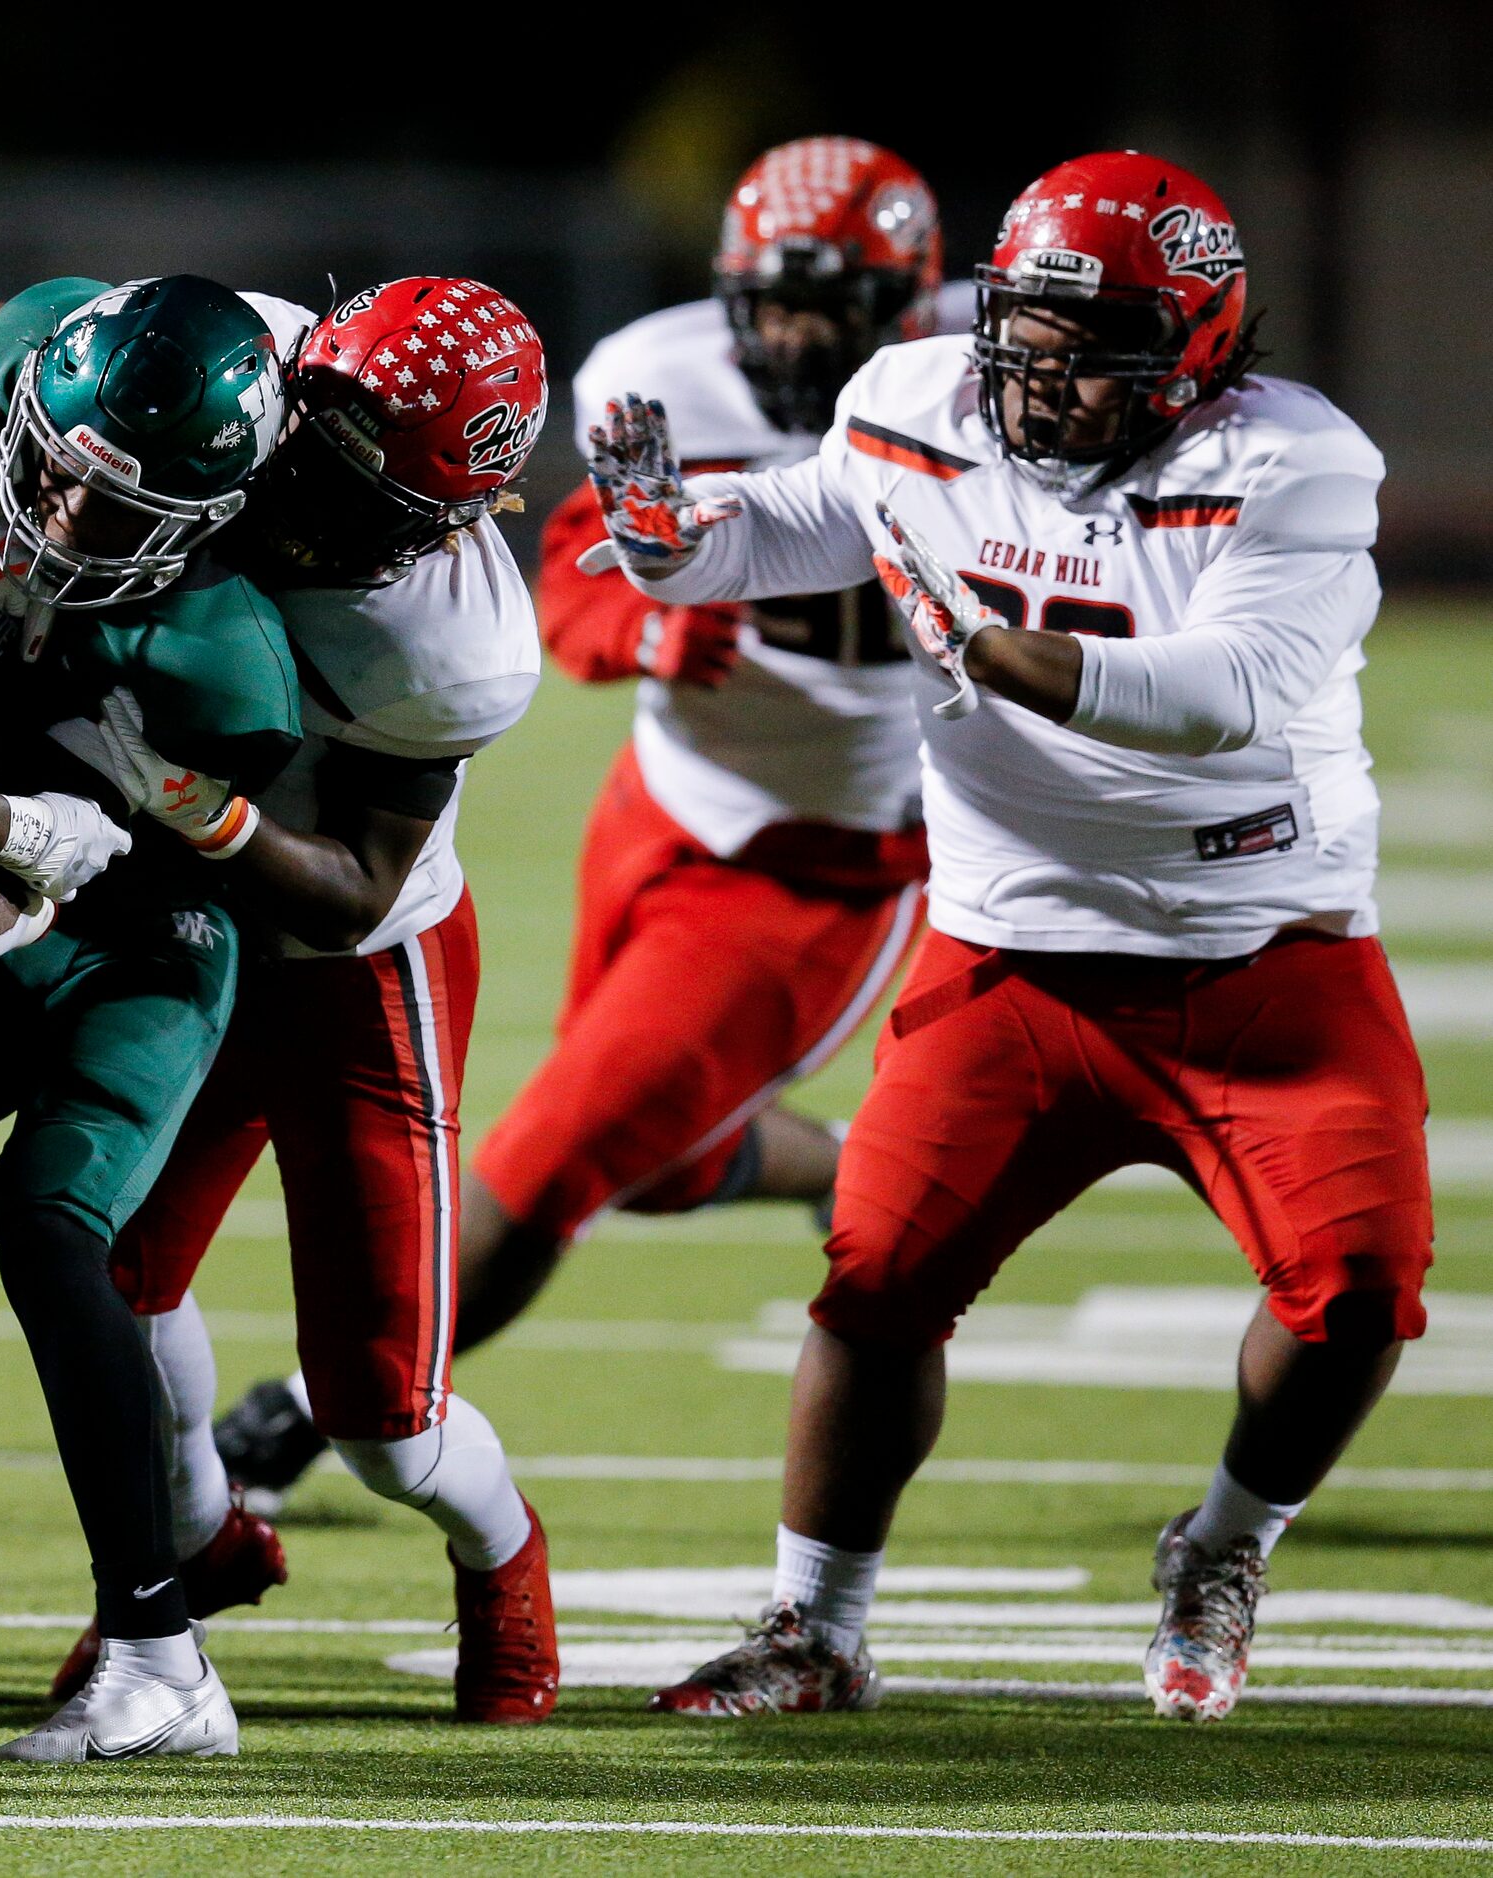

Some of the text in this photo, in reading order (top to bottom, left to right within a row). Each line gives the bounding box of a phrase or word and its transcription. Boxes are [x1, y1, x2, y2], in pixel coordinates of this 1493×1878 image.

[76, 431, 135, 476] Riddell
[979, 539, 1101, 586] CEDAR HILL
